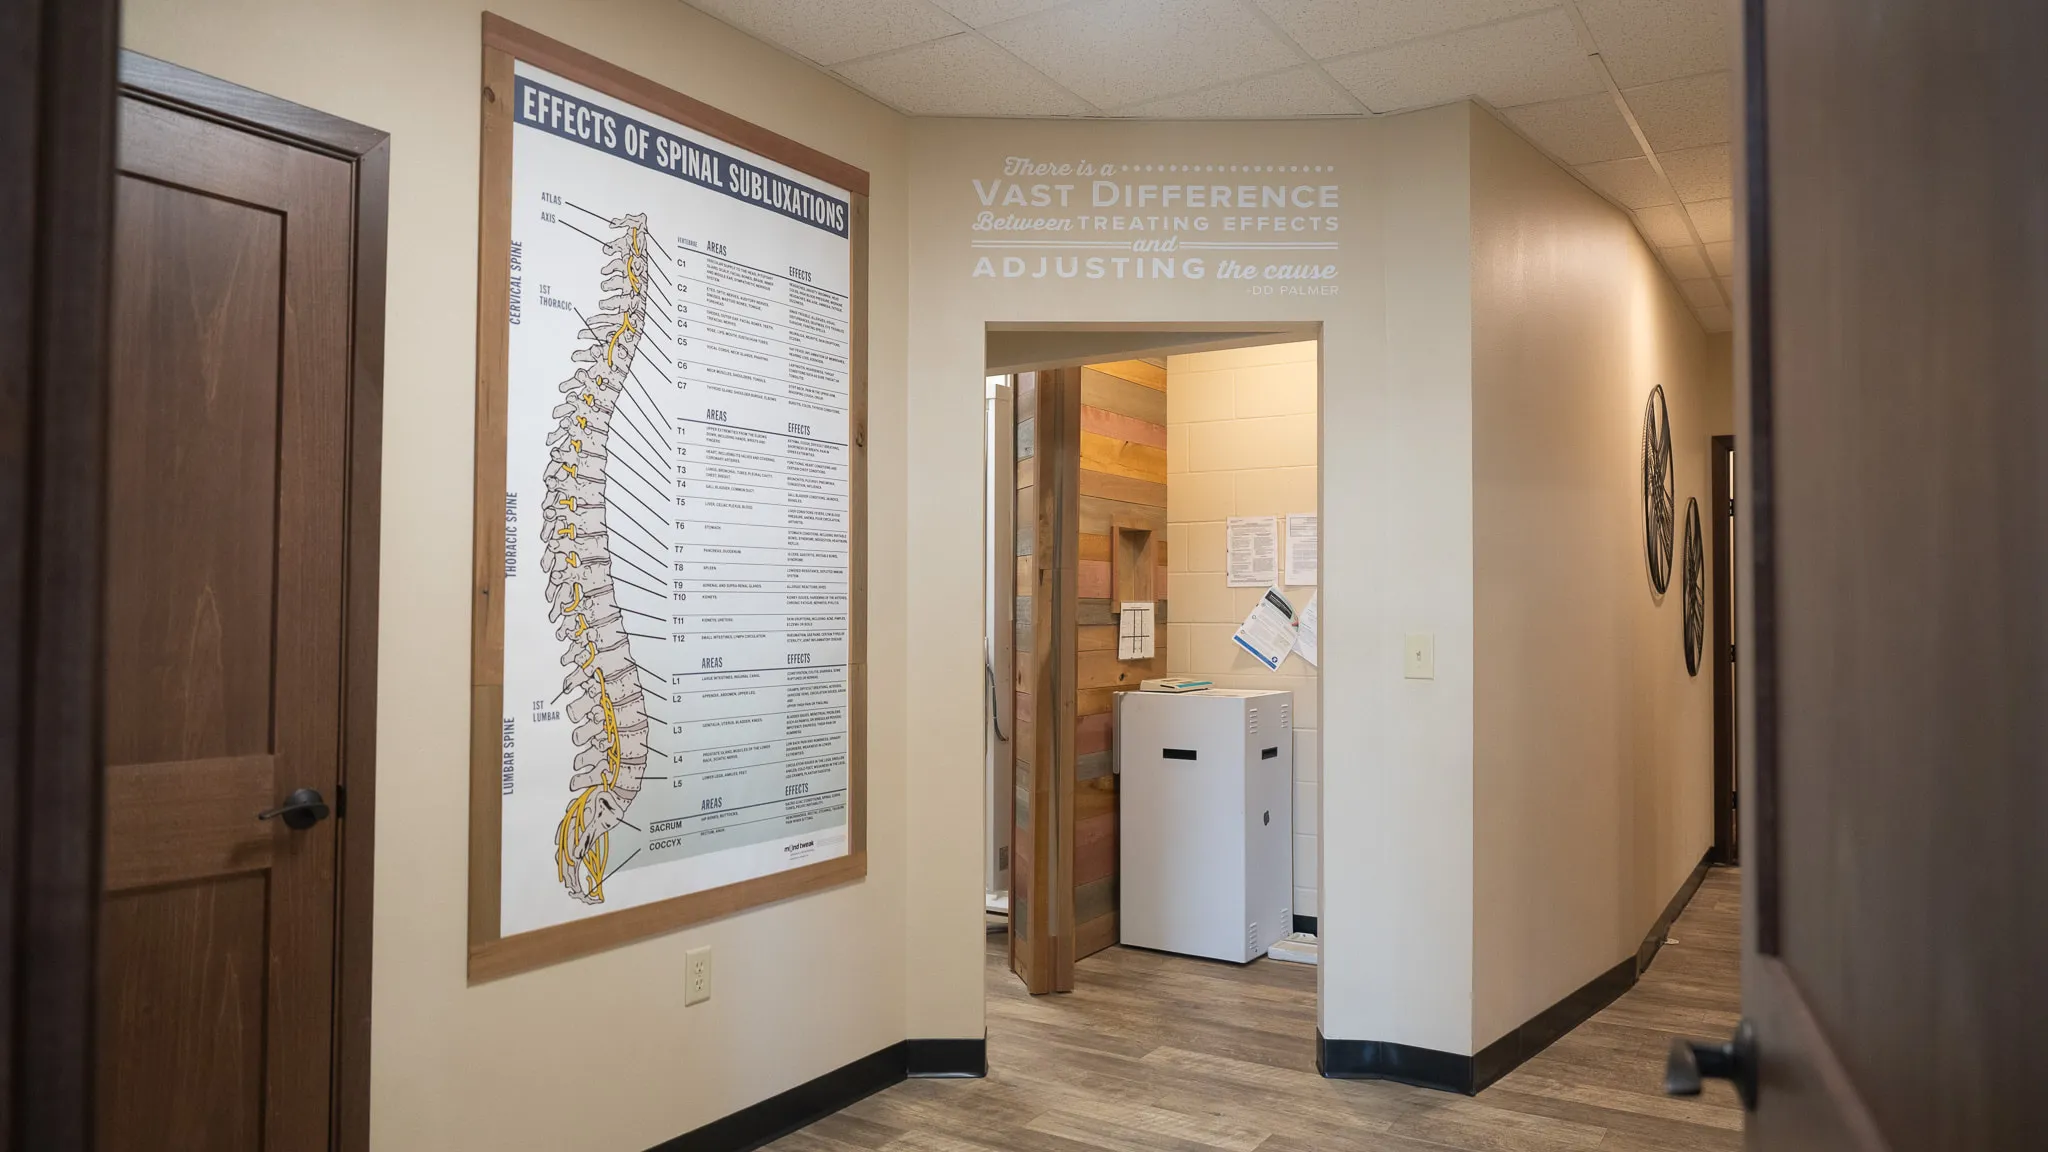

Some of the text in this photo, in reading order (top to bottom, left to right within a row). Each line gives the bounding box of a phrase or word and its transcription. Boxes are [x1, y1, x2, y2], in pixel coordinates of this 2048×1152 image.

[523, 85, 844, 231] EFFECTS OF SPINAL SUBLUXATIONS
[1003, 156, 1116, 176] There is a
[541, 192, 562, 205] ATLAS
[972, 179, 1339, 208] VAST DIFFERENCE
[541, 211, 556, 223] AXIS
[972, 211, 1339, 232] Between TREATING EFFECTS
[707, 241, 727, 256] AREAS
[1132, 236, 1179, 252] and
[677, 259, 686, 267] C1
[972, 257, 1338, 280] ADJUSTING the cause
[789, 266, 811, 282] EFFECTS
[509, 240, 522, 325] CERVICAL SPINE
[677, 284, 687, 292] C2
[539, 284, 551, 295] 1ST
[1280, 285, 1339, 296] PALMER
[539, 296, 572, 311] THORACIC
[677, 305, 687, 313] C3
[677, 320, 687, 328] C4
[677, 337, 687, 346] C5
[677, 361, 687, 369] C6
[677, 381, 687, 389] C7
[707, 409, 727, 422] AREAS
[677, 427, 685, 435] T1
[788, 422, 811, 436] EFFECTS
[677, 447, 686, 455] T2
[677, 466, 686, 474] T3
[677, 480, 686, 488] T4
[676, 522, 684, 530] T6
[505, 492, 517, 578] THORACIC SPINE
[673, 593, 686, 601] T10
[702, 657, 723, 669] AREAS
[787, 653, 811, 664] EFFECTS
[672, 677, 680, 685] L1
[672, 695, 682, 703] L2
[533, 701, 544, 710] 1ST
[533, 712, 560, 722] LUMBAR
[673, 726, 682, 734] L3
[503, 717, 515, 795] LUMBAR SPINE
[673, 780, 682, 788] L5
[785, 783, 809, 796] EFFECTS
[701, 797, 723, 811] AREAS
[650, 821, 682, 833] SACRUM
[649, 838, 682, 851] COCCYX
